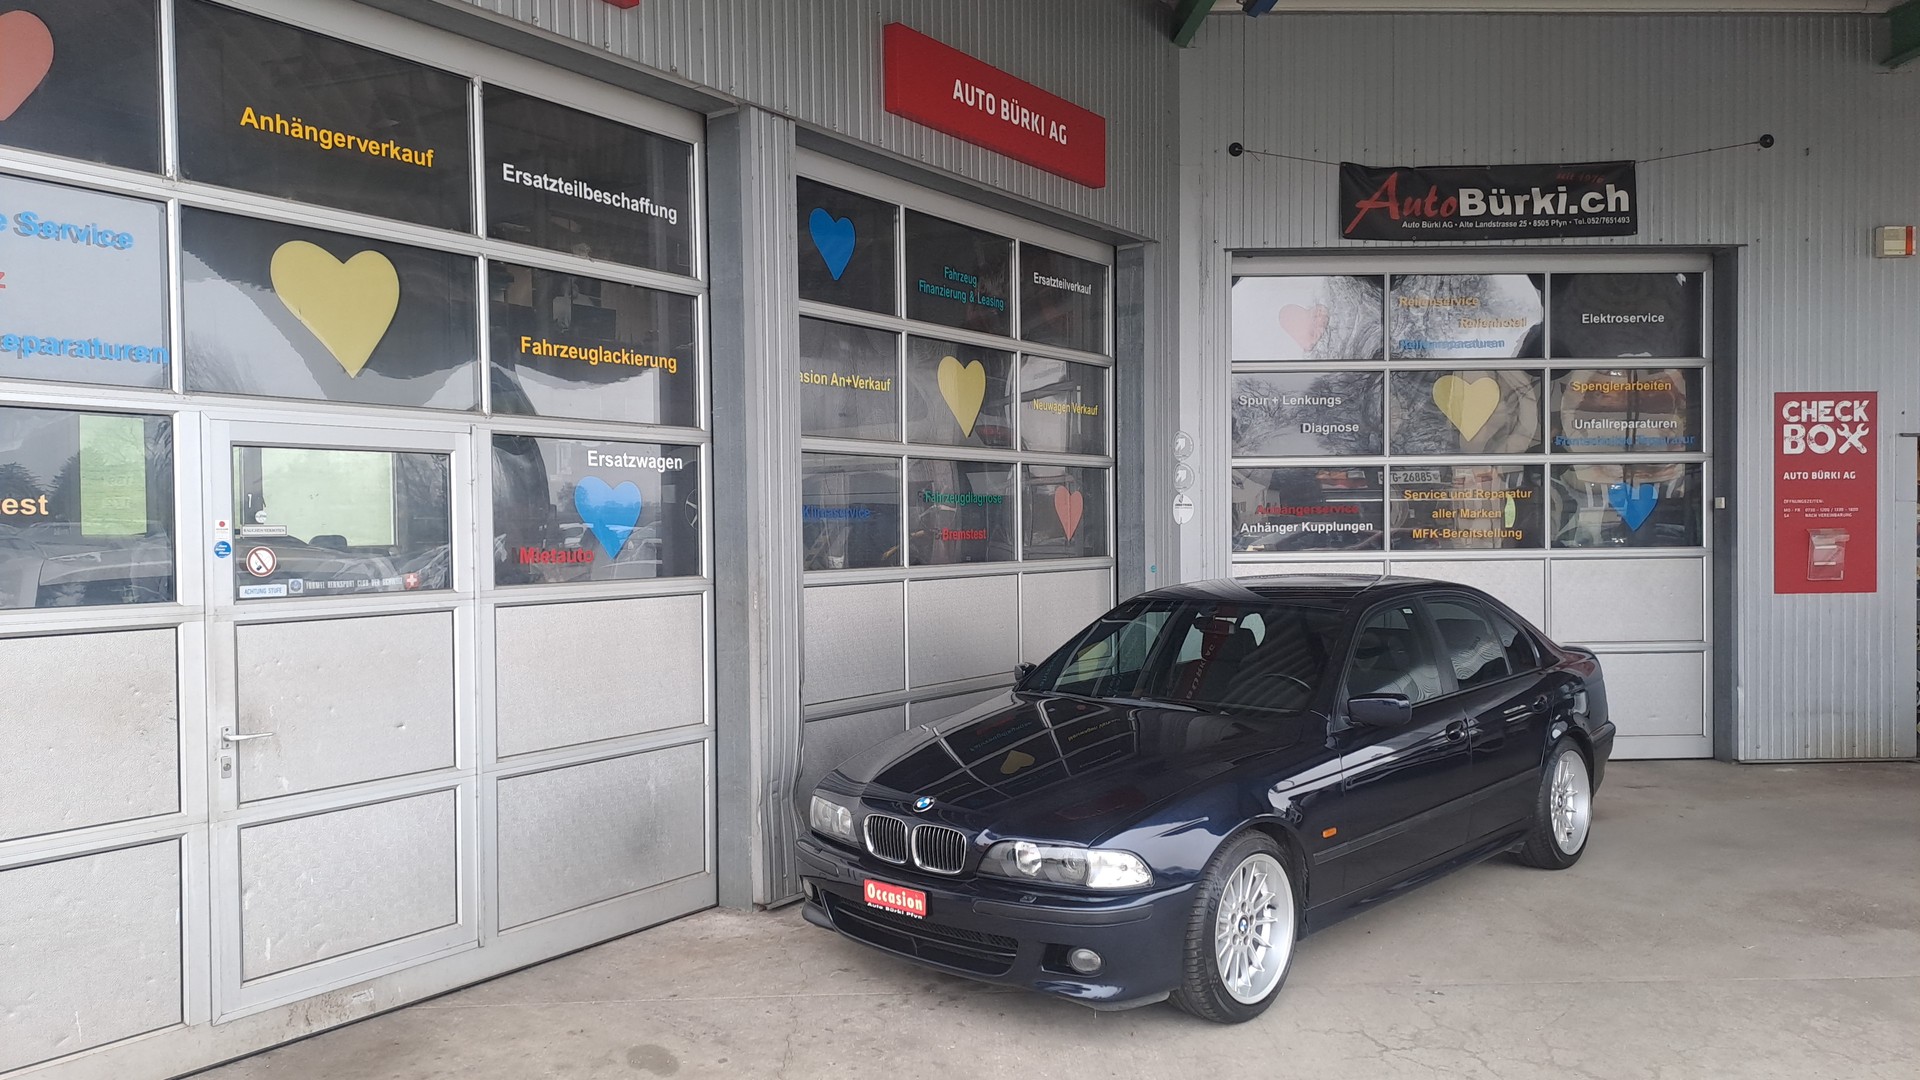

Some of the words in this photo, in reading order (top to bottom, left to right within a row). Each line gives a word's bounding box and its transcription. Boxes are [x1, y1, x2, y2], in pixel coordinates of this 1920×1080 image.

[953, 79, 996, 116] AUTO
[1000, 96, 1045, 137] BÜRKI
[1049, 121, 1068, 145] AG
[240, 107, 435, 169] Anhängerverkauf
[502, 163, 678, 225] Ersatzteilbeschaffung
[16, 211, 135, 250] Service
[1422, 220, 1441, 228] Bürki
[1475, 220, 1517, 228] Landstrasse
[1551, 220, 1568, 230] Pfyn
[944, 266, 978, 288] Fahrzeug
[1033, 272, 1092, 296] Ersatzteilverkauf
[918, 280, 967, 304] Finanzierung
[970, 292, 975, 302] &
[977, 293, 1004, 312] Leasing
[1581, 312, 1665, 324] Elektroservice
[520, 336, 678, 374] Fahrzeuglackierung
[830, 372, 891, 392] An+Verkauf
[1572, 380, 1672, 393] Spenglerarbeiten
[1033, 398, 1070, 414] Neuwagen
[1072, 401, 1098, 416] Verkauf
[1239, 395, 1268, 408] Spur
[1283, 395, 1342, 408] Lenkungs
[1782, 400, 1870, 423] CHECK
[1302, 422, 1360, 435] Diagnose
[1574, 419, 1678, 430] Unfallreparaturen
[1783, 423, 1870, 455] BOX
[587, 450, 683, 472] Ersatzwagen
[1784, 472, 1809, 480] AUTO
[1812, 470, 1840, 480] BÜRKI
[1843, 471, 1856, 480] AG
[925, 490, 1002, 506] Fahrzeugdiagnose
[1404, 490, 1447, 500] Service
[1450, 490, 1472, 499] und
[1476, 489, 1532, 500] Reparatur
[802, 504, 870, 520] Klimaservice
[1432, 508, 1456, 518] aller
[1460, 508, 1502, 518] Marken
[942, 528, 987, 540] Bremstest
[1240, 522, 1298, 534] Anhänger
[1302, 522, 1374, 534] Kupplungen
[1412, 528, 1523, 540] MFK-Bereitstellung
[519, 547, 595, 564] Mietauto
[867, 883, 923, 911] Occasion
